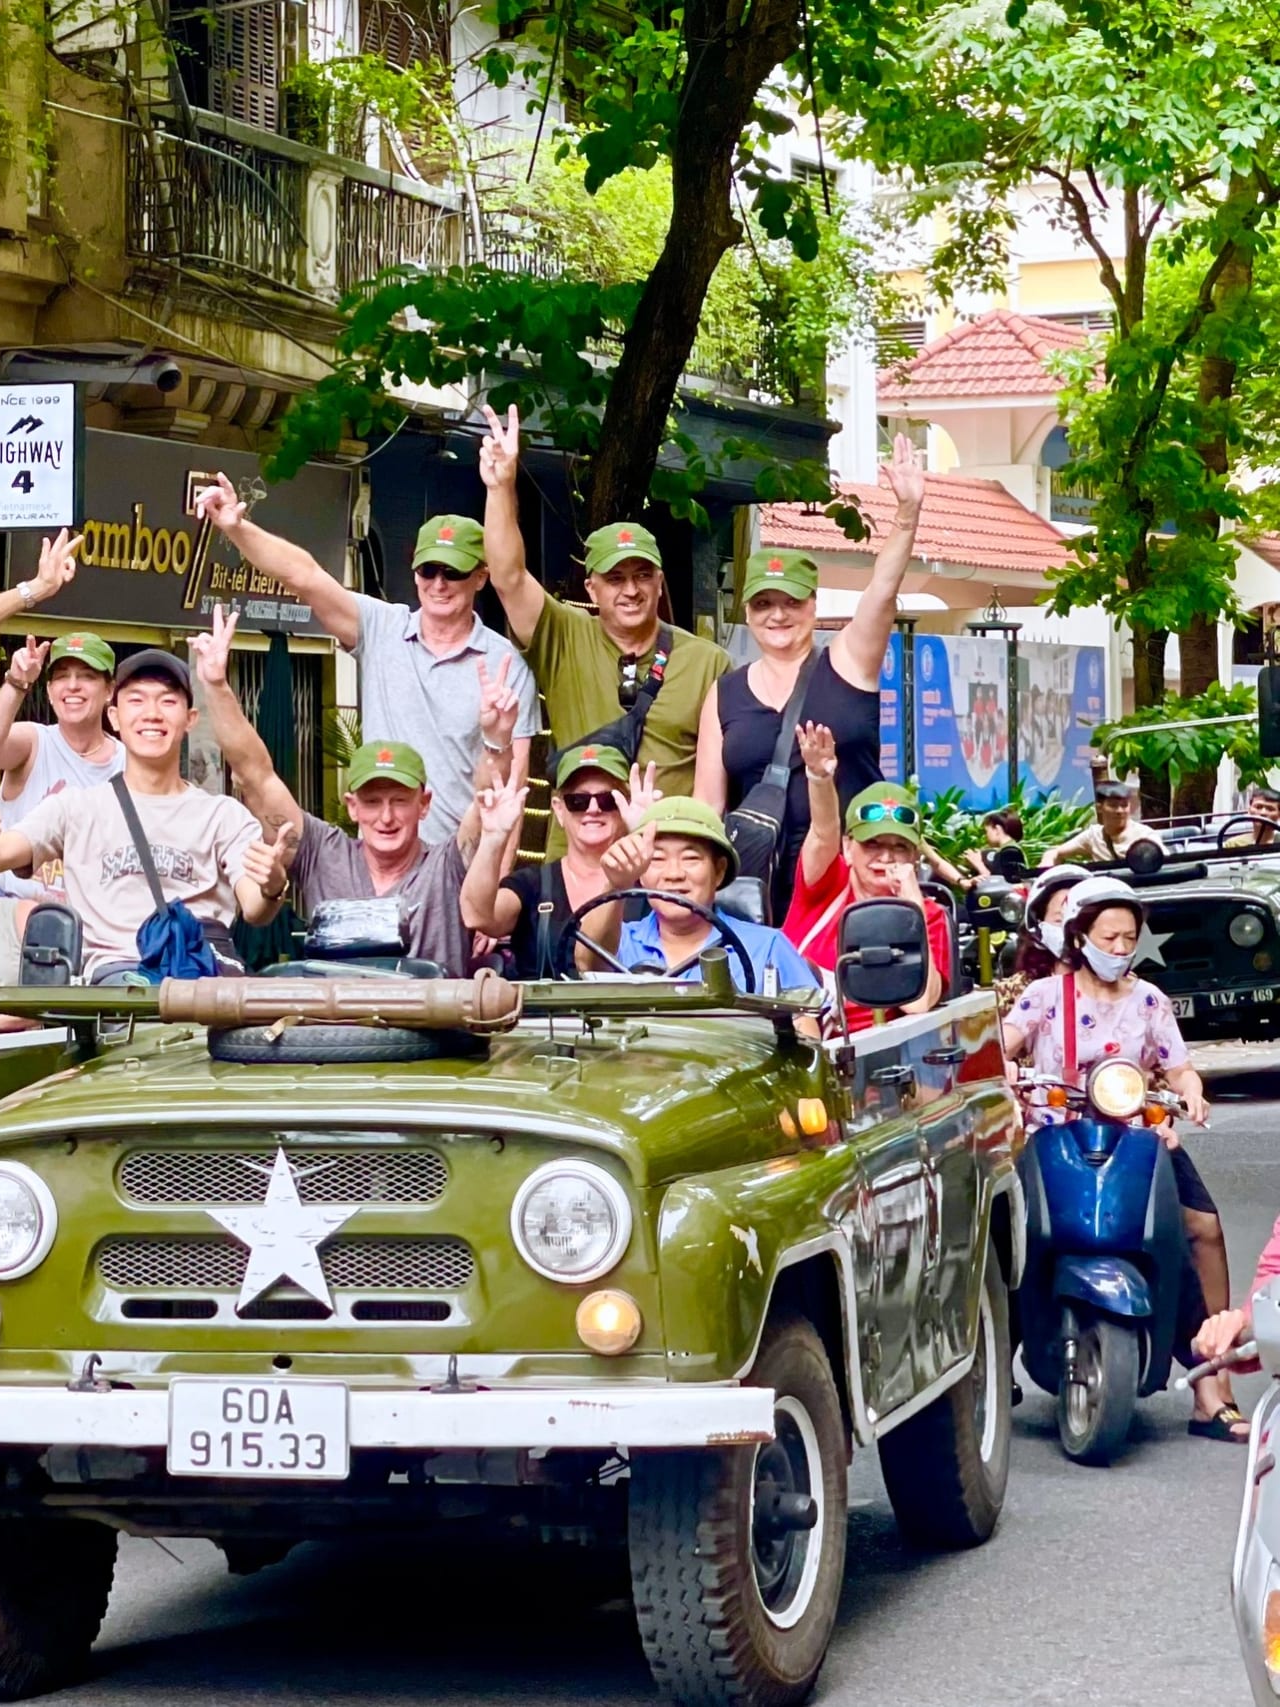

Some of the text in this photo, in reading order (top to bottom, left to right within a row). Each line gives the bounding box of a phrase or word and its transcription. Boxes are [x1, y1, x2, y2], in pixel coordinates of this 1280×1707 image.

[32, 395, 61, 405] 1999
[11, 470, 35, 494] 4
[73, 503, 191, 575] amboo
[222, 1387, 294, 1425] 60A
[190, 1430, 326, 1469] 915.33
